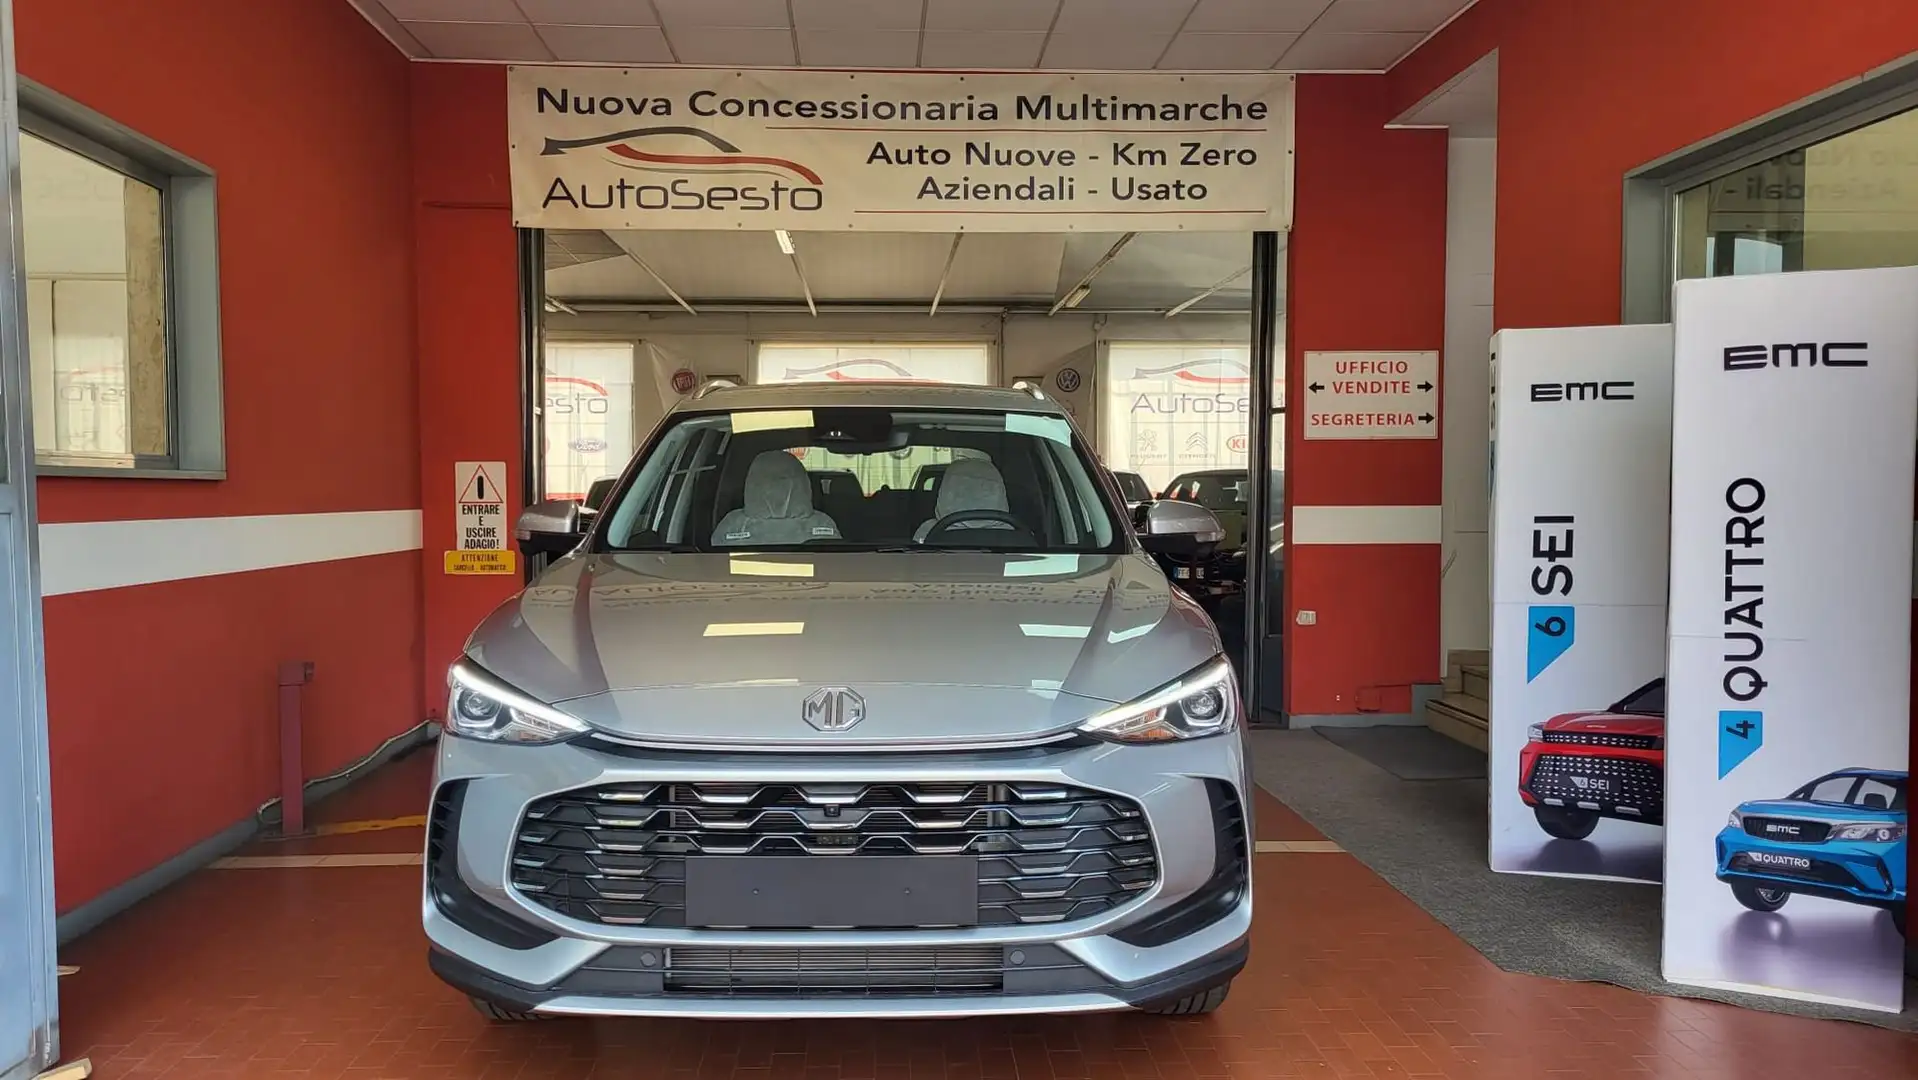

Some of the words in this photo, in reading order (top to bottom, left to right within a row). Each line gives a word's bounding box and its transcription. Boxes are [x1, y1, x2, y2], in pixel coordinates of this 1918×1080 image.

[536, 87, 672, 116] Nuova
[688, 89, 998, 121] Concessionaria
[1015, 94, 1268, 122] Multimarche
[866, 141, 952, 167] Auto
[964, 141, 1076, 167] Nuove
[1112, 142, 1167, 167] Km
[1179, 142, 1258, 167] Zero
[542, 178, 823, 211] AutoSesto
[916, 176, 1075, 201] Aziendali
[1111, 176, 1208, 201] Usato
[1724, 342, 1868, 371] EMC
[1335, 361, 1409, 374] UFFICIO
[1332, 380, 1411, 394] VENDITE
[1531, 381, 1635, 402] EMC
[1131, 393, 1249, 414] AutoSe
[1311, 413, 1415, 426] SEGRETERIA
[1232, 439, 1246, 449] KI
[462, 504, 500, 515] ENTRARE
[478, 516, 484, 526] E
[466, 527, 497, 538] USCIRE
[464, 538, 499, 550] ADAGIO!
[461, 554, 499, 562] ATTENZIONE
[1530, 515, 1575, 597] SEI
[1723, 477, 1768, 701] QUATTRO
[1535, 616, 1566, 637] 6
[808, 691, 862, 727] MG
[1725, 720, 1756, 740] 4
[1589, 778, 1610, 791] SEI
[1766, 824, 1800, 835] EMC
[1762, 854, 1811, 868] QUATTRO
